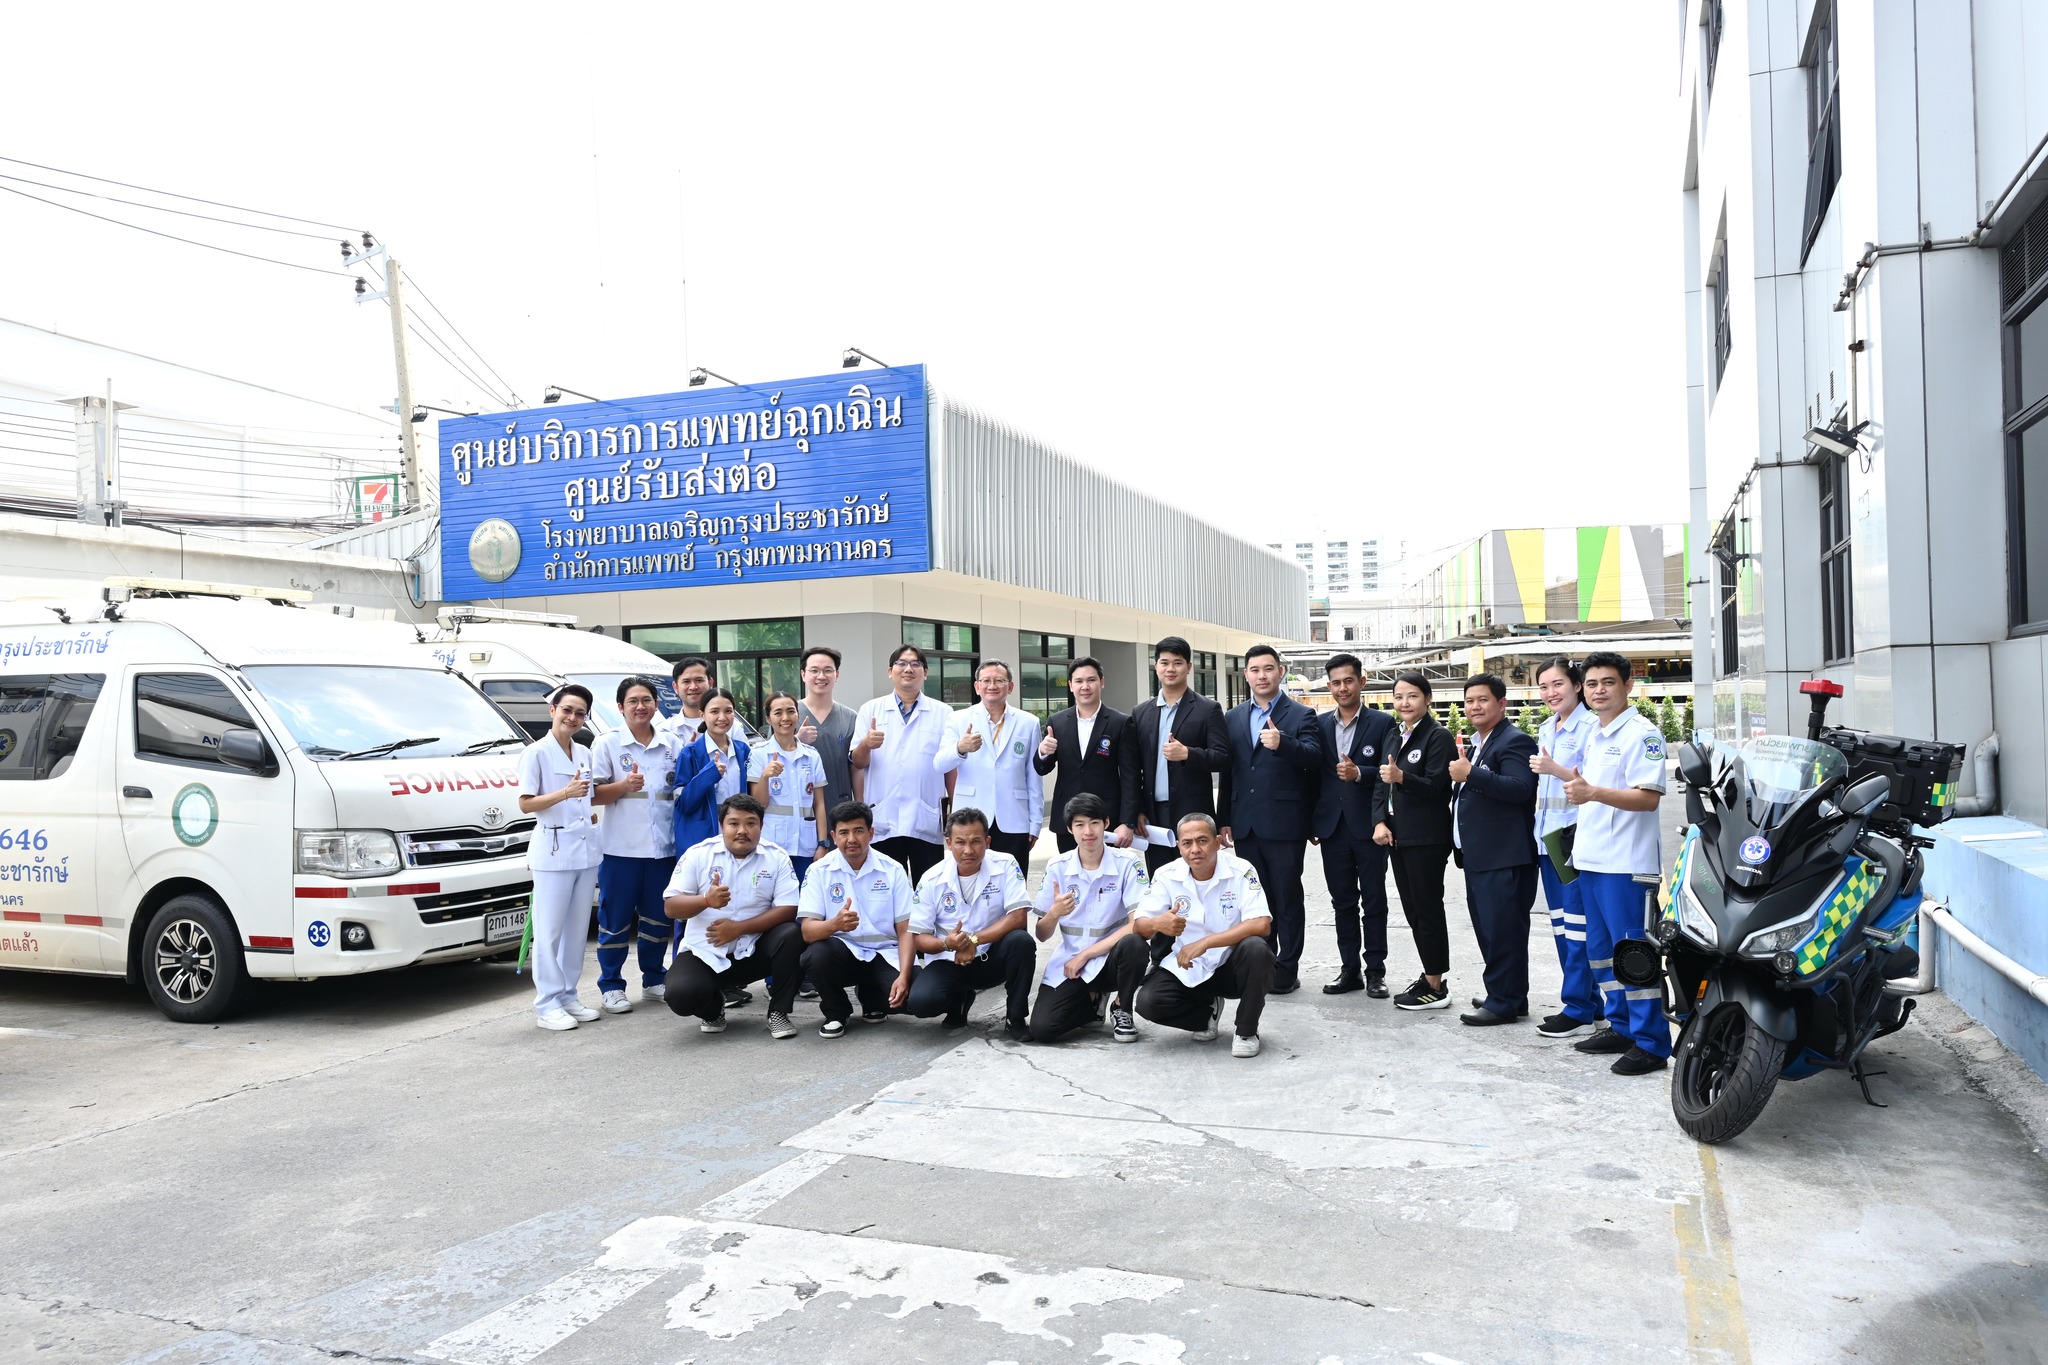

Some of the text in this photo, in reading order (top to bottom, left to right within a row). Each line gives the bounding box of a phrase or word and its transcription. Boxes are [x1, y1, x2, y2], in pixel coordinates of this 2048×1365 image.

[451, 383, 903, 486] ศูนย์บริการการแพทย์ฉุกเฉิน
[564, 448, 778, 522] ศูนย์รับส่งต่อ
[541, 492, 890, 550] โรงพยาบาลเจริญกรุงประชารักษ์
[543, 537, 893, 582] สำนักการแพทย์ กรุงเทพมหานคร
[0, 630, 114, 667] รุงประชารักษ์
[1736, 865, 1763, 875] HONDA
[310, 925, 329, 943] 33
